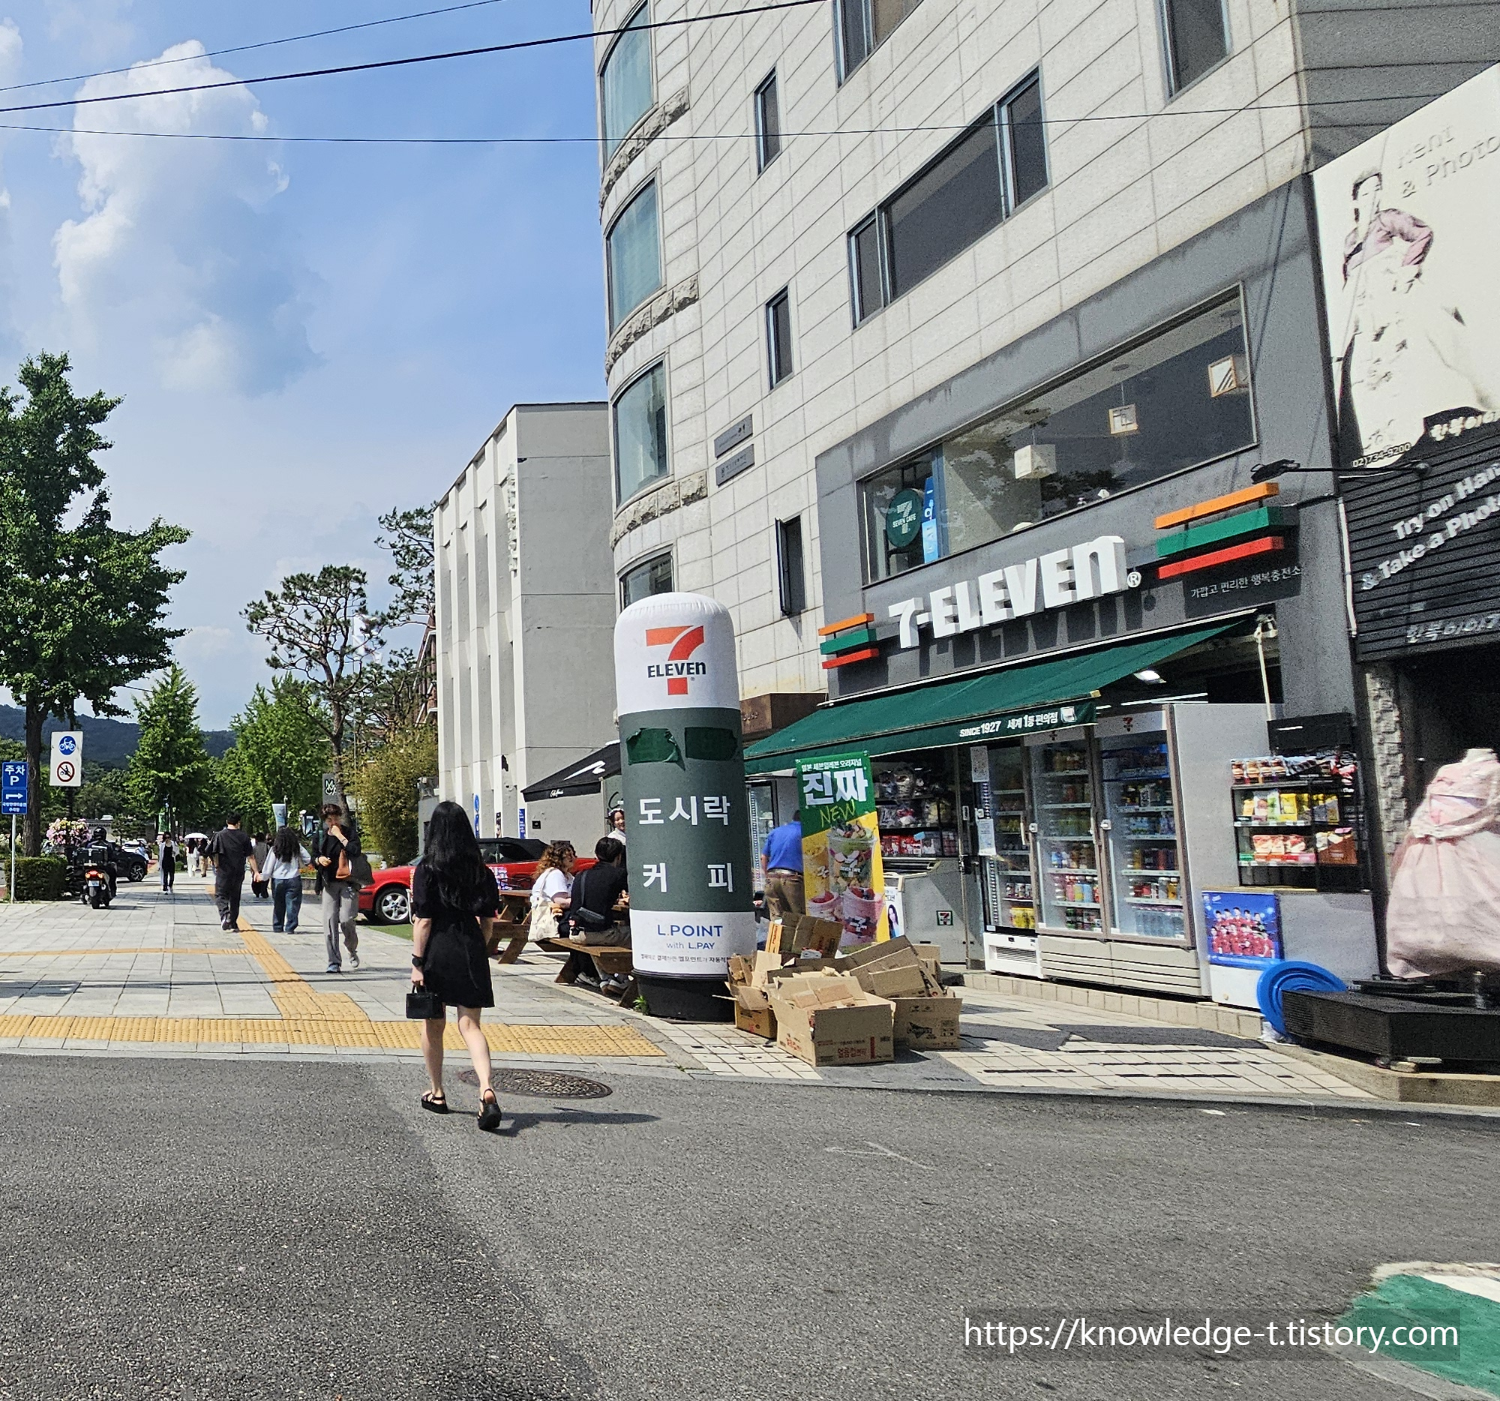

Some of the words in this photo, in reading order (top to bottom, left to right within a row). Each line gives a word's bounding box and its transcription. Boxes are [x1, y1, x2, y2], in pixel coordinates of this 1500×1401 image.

[1392, 512, 1424, 540] Try
[1427, 494, 1454, 518] on
[1378, 544, 1426, 580] Take
[1428, 532, 1445, 549] a
[1446, 493, 1500, 538] Phot
[1220, 576, 1249, 593] 편리한
[1250, 565, 1303, 586] 행복충전소
[645, 625, 705, 696] 7
[959, 727, 981, 738] SINCE
[981, 721, 1002, 734] 1927
[4, 764, 26, 775] 주차
[10, 776, 20, 786] P
[802, 767, 869, 806] 진짜
[638, 796, 731, 826] 도시락
[819, 799, 856, 828] NEW
[657, 924, 724, 937] L.POINT
[666, 941, 685, 950] with
[688, 942, 716, 950] L.PAY
